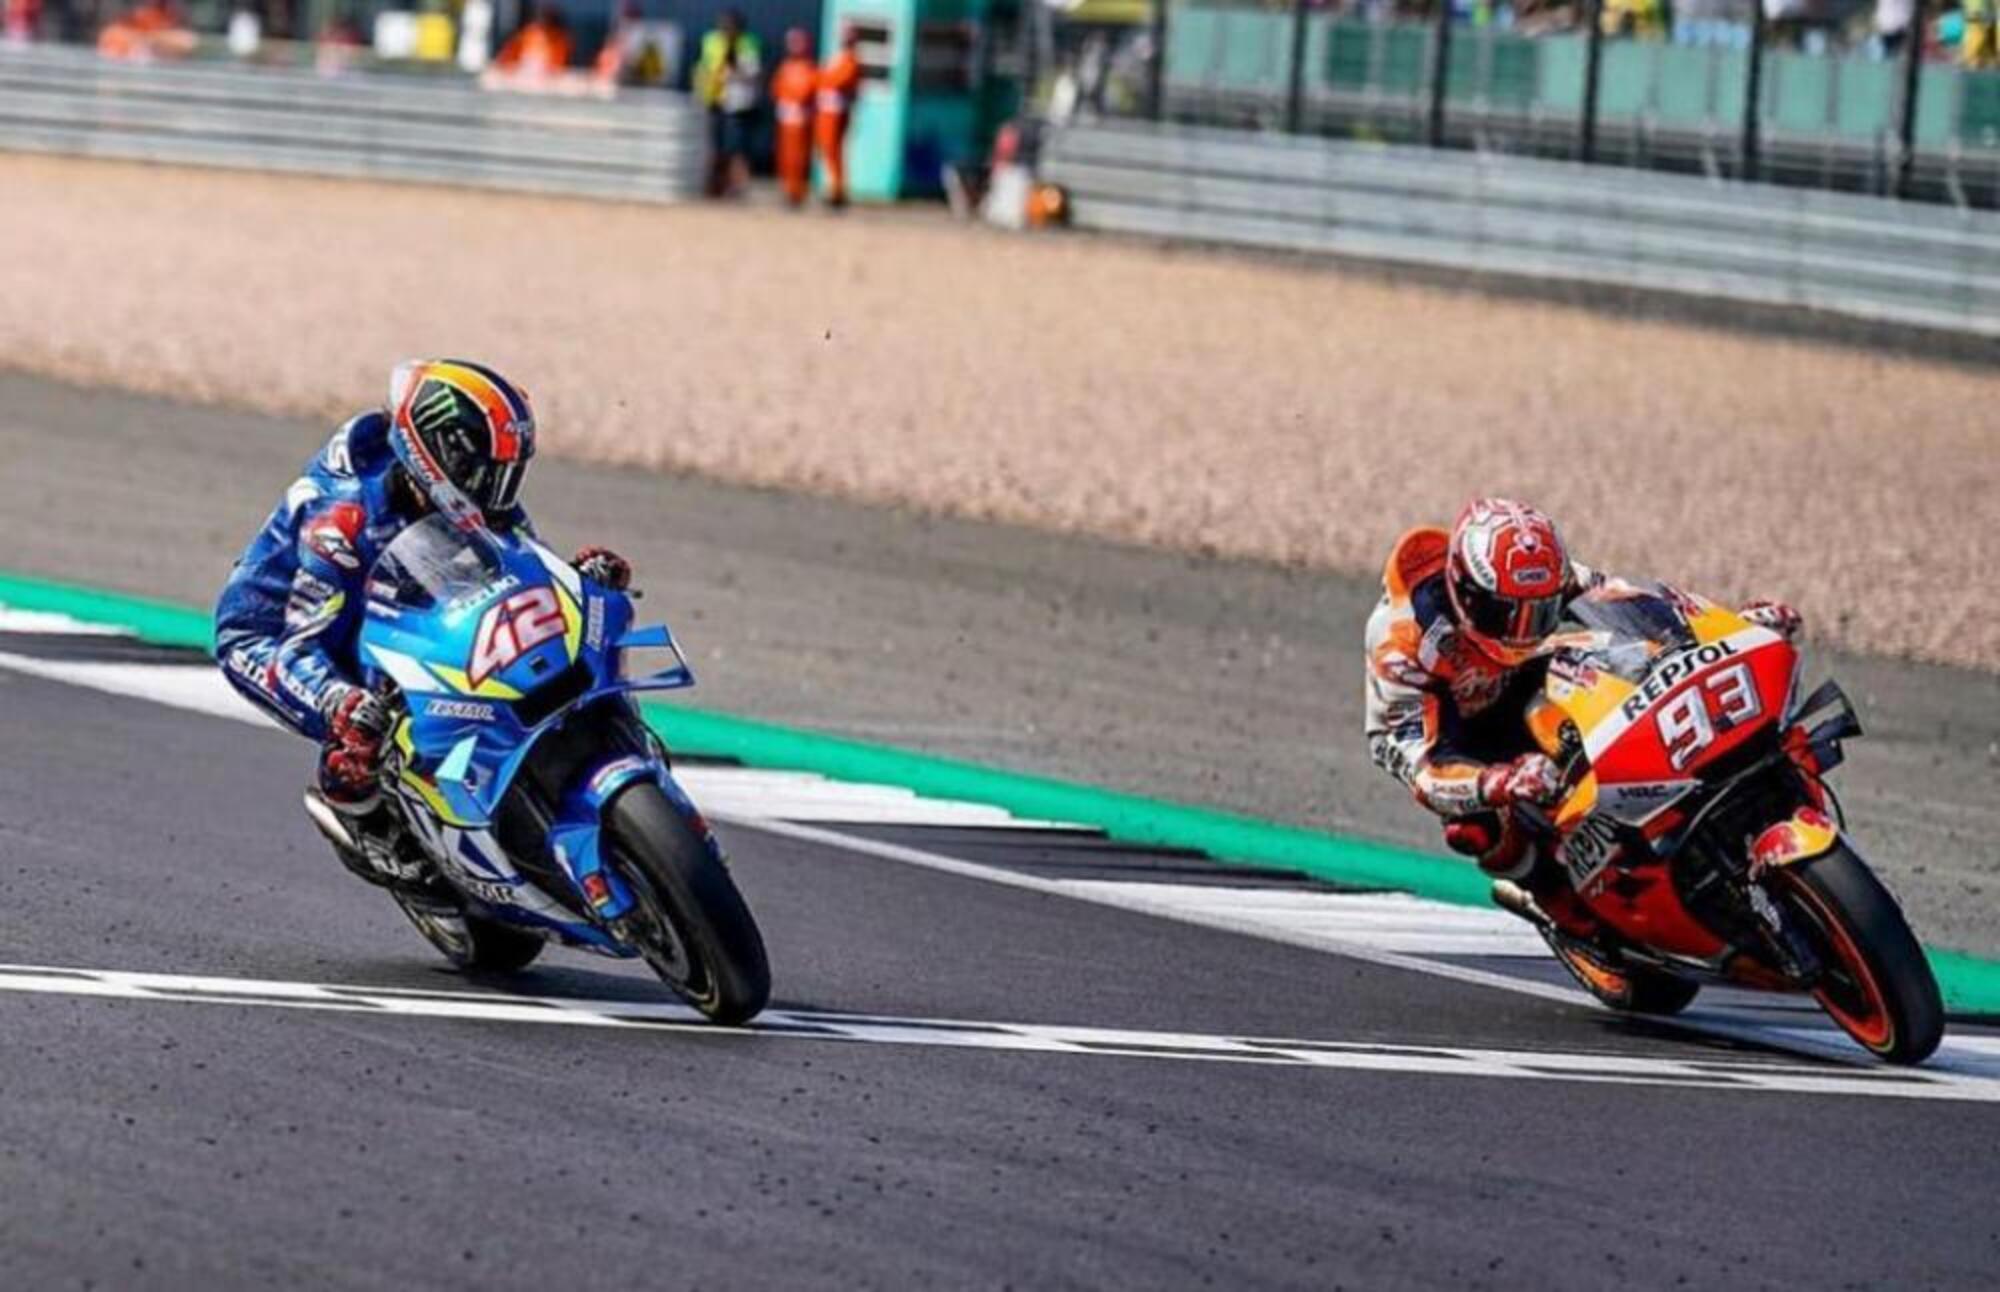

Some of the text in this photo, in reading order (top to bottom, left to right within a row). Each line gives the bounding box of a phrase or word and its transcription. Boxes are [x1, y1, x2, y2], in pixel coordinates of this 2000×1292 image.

[466, 584, 570, 690] 42
[1621, 640, 1739, 721] REPSOL
[1655, 662, 1762, 772] 93
